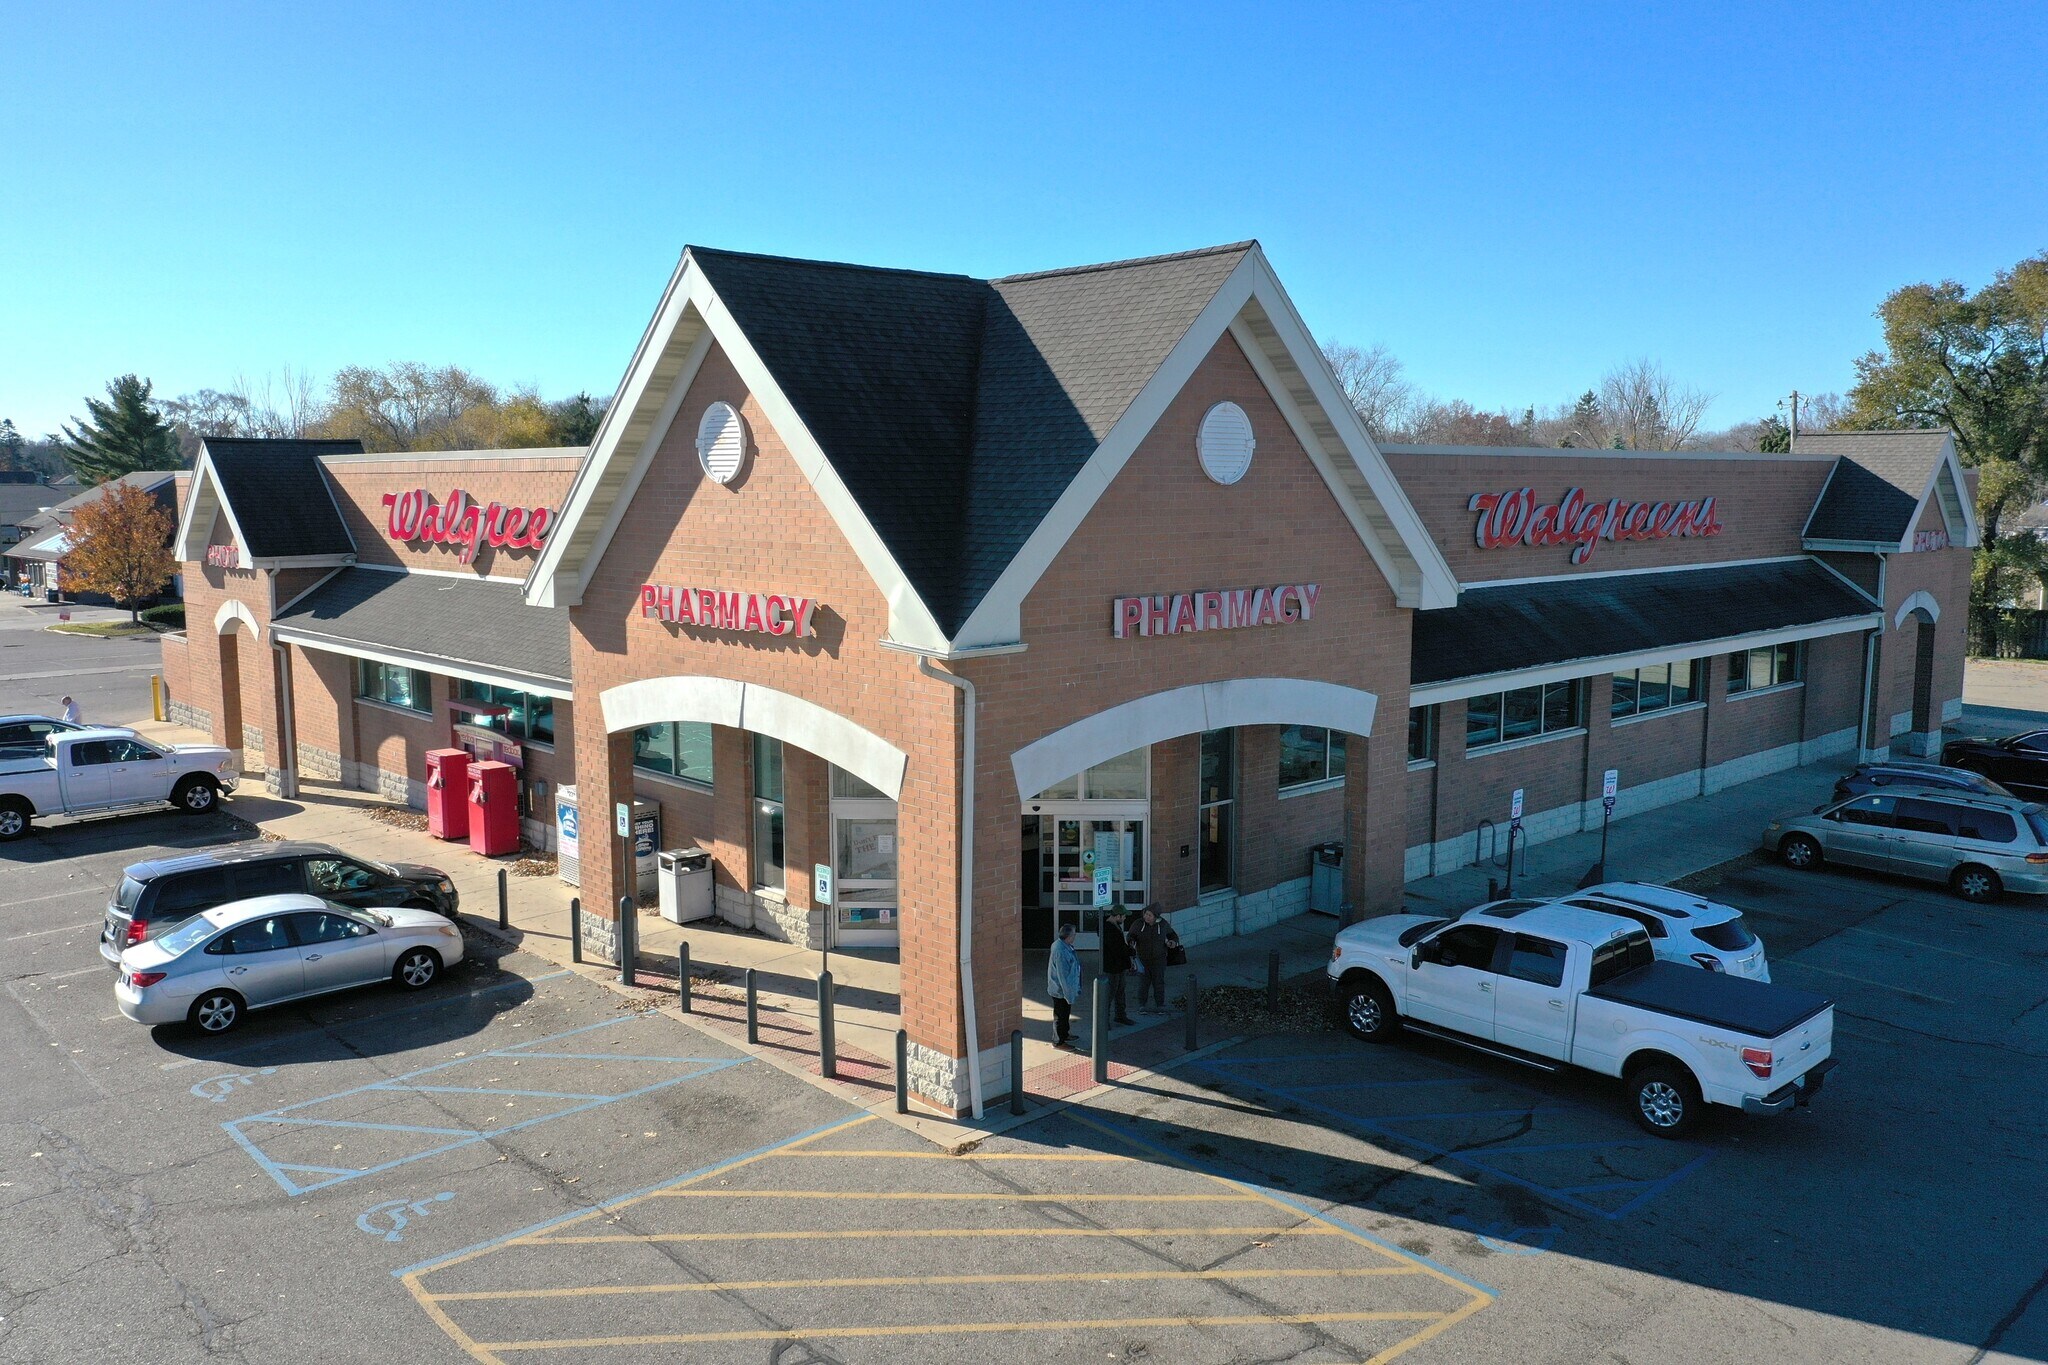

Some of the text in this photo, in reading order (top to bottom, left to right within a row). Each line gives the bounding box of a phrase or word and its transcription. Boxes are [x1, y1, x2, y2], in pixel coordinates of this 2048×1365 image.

[1468, 486, 1723, 565] Walgreens
[641, 584, 814, 638] PHARMACY
[1114, 584, 1322, 639] PHARMACY
